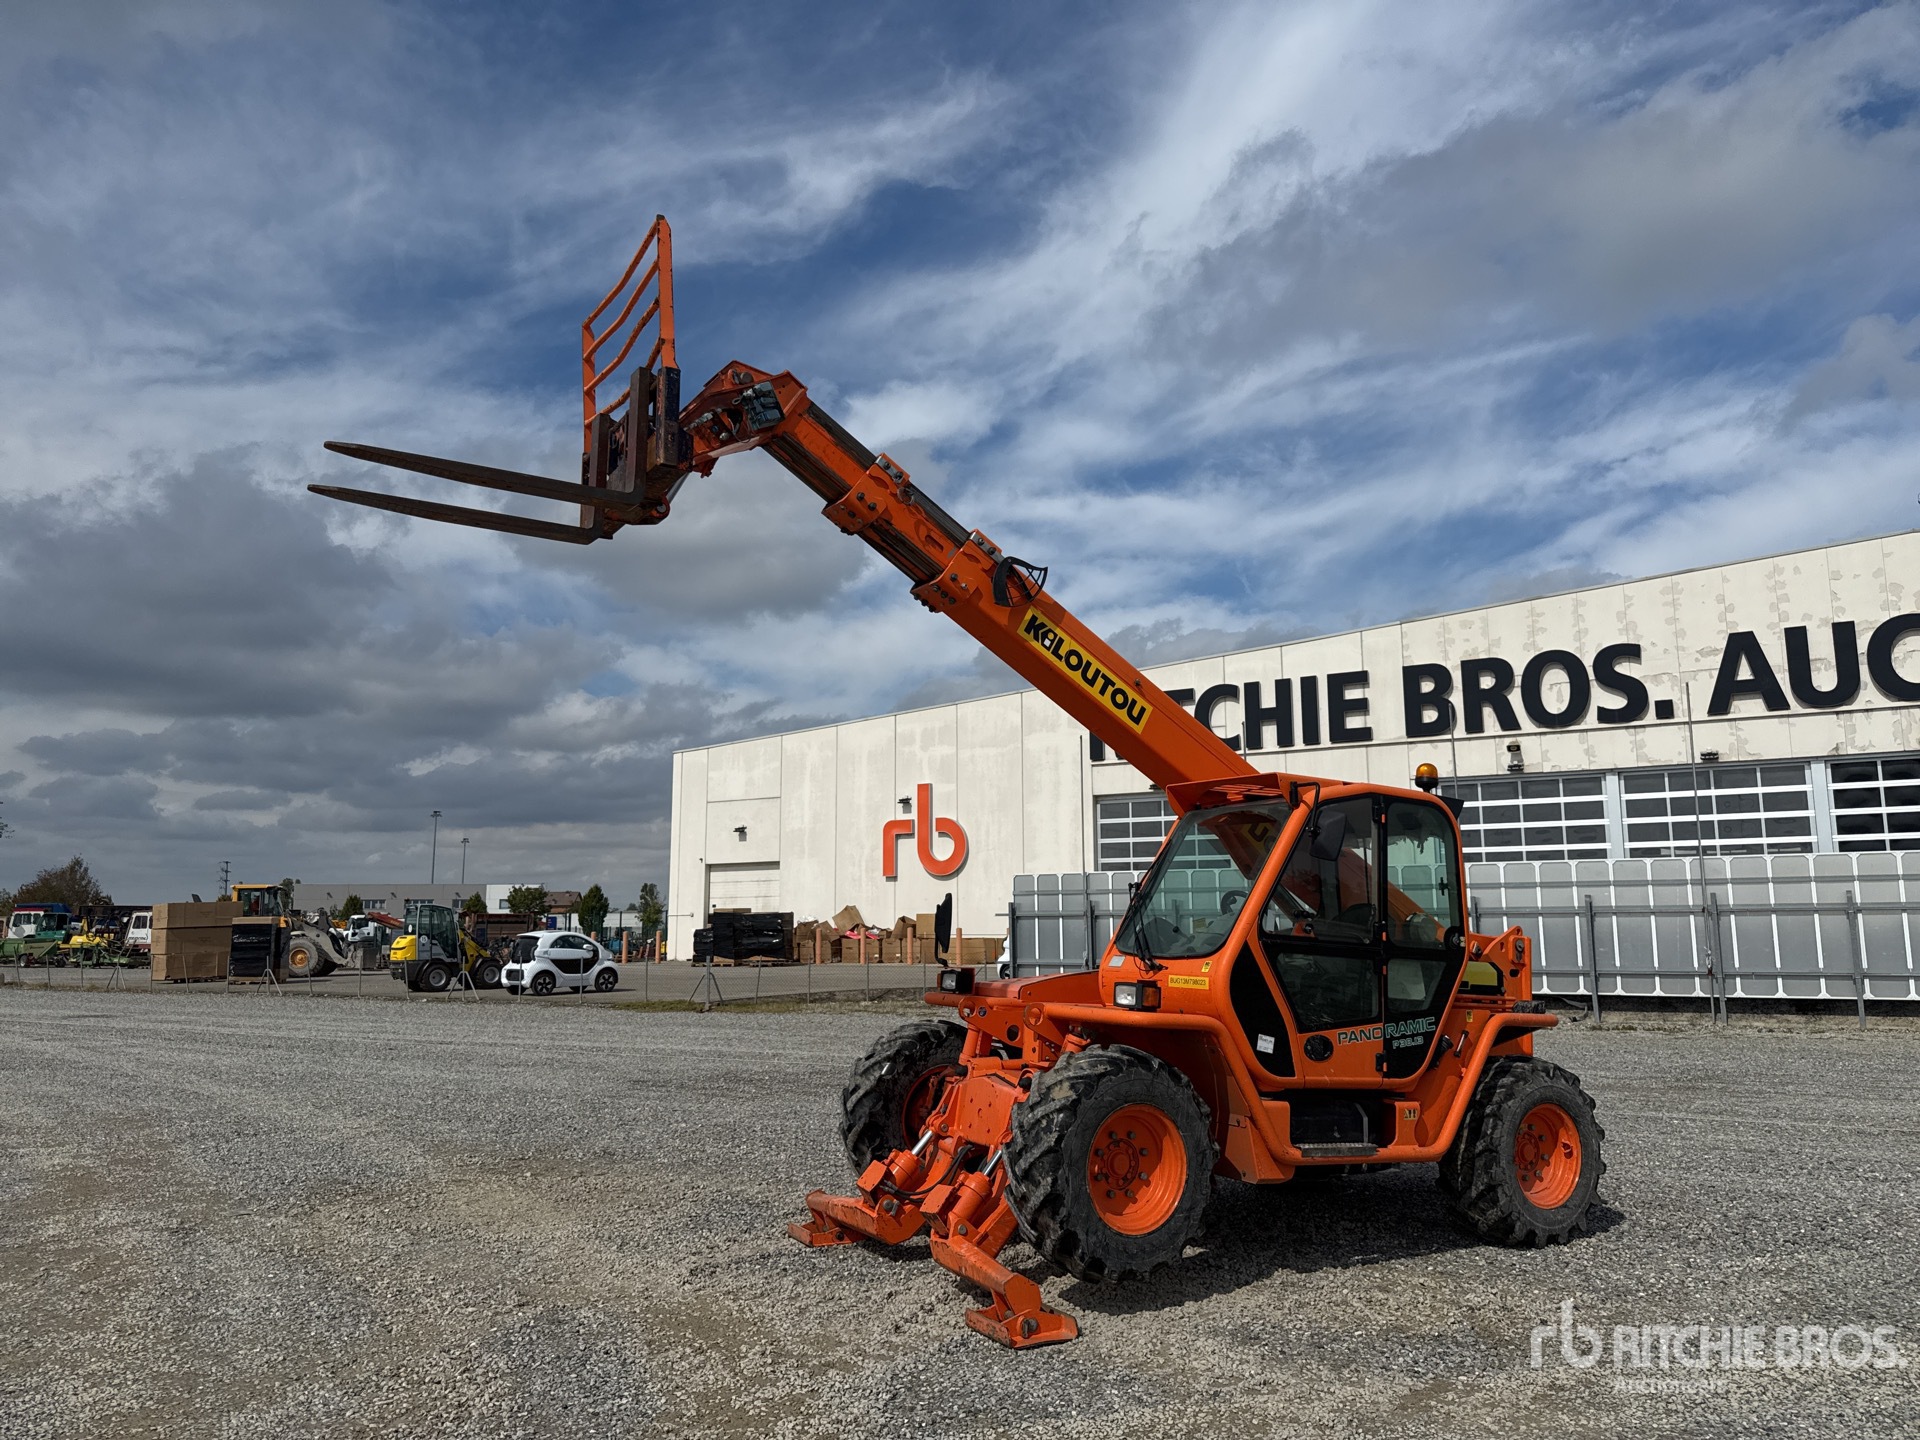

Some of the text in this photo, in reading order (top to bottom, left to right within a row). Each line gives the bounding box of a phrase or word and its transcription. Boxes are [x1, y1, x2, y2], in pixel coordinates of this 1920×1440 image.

[1402, 642, 1675, 738] BROS.
[882, 783, 970, 878] rb
[1337, 1016, 1436, 1046] PANORAMIC
